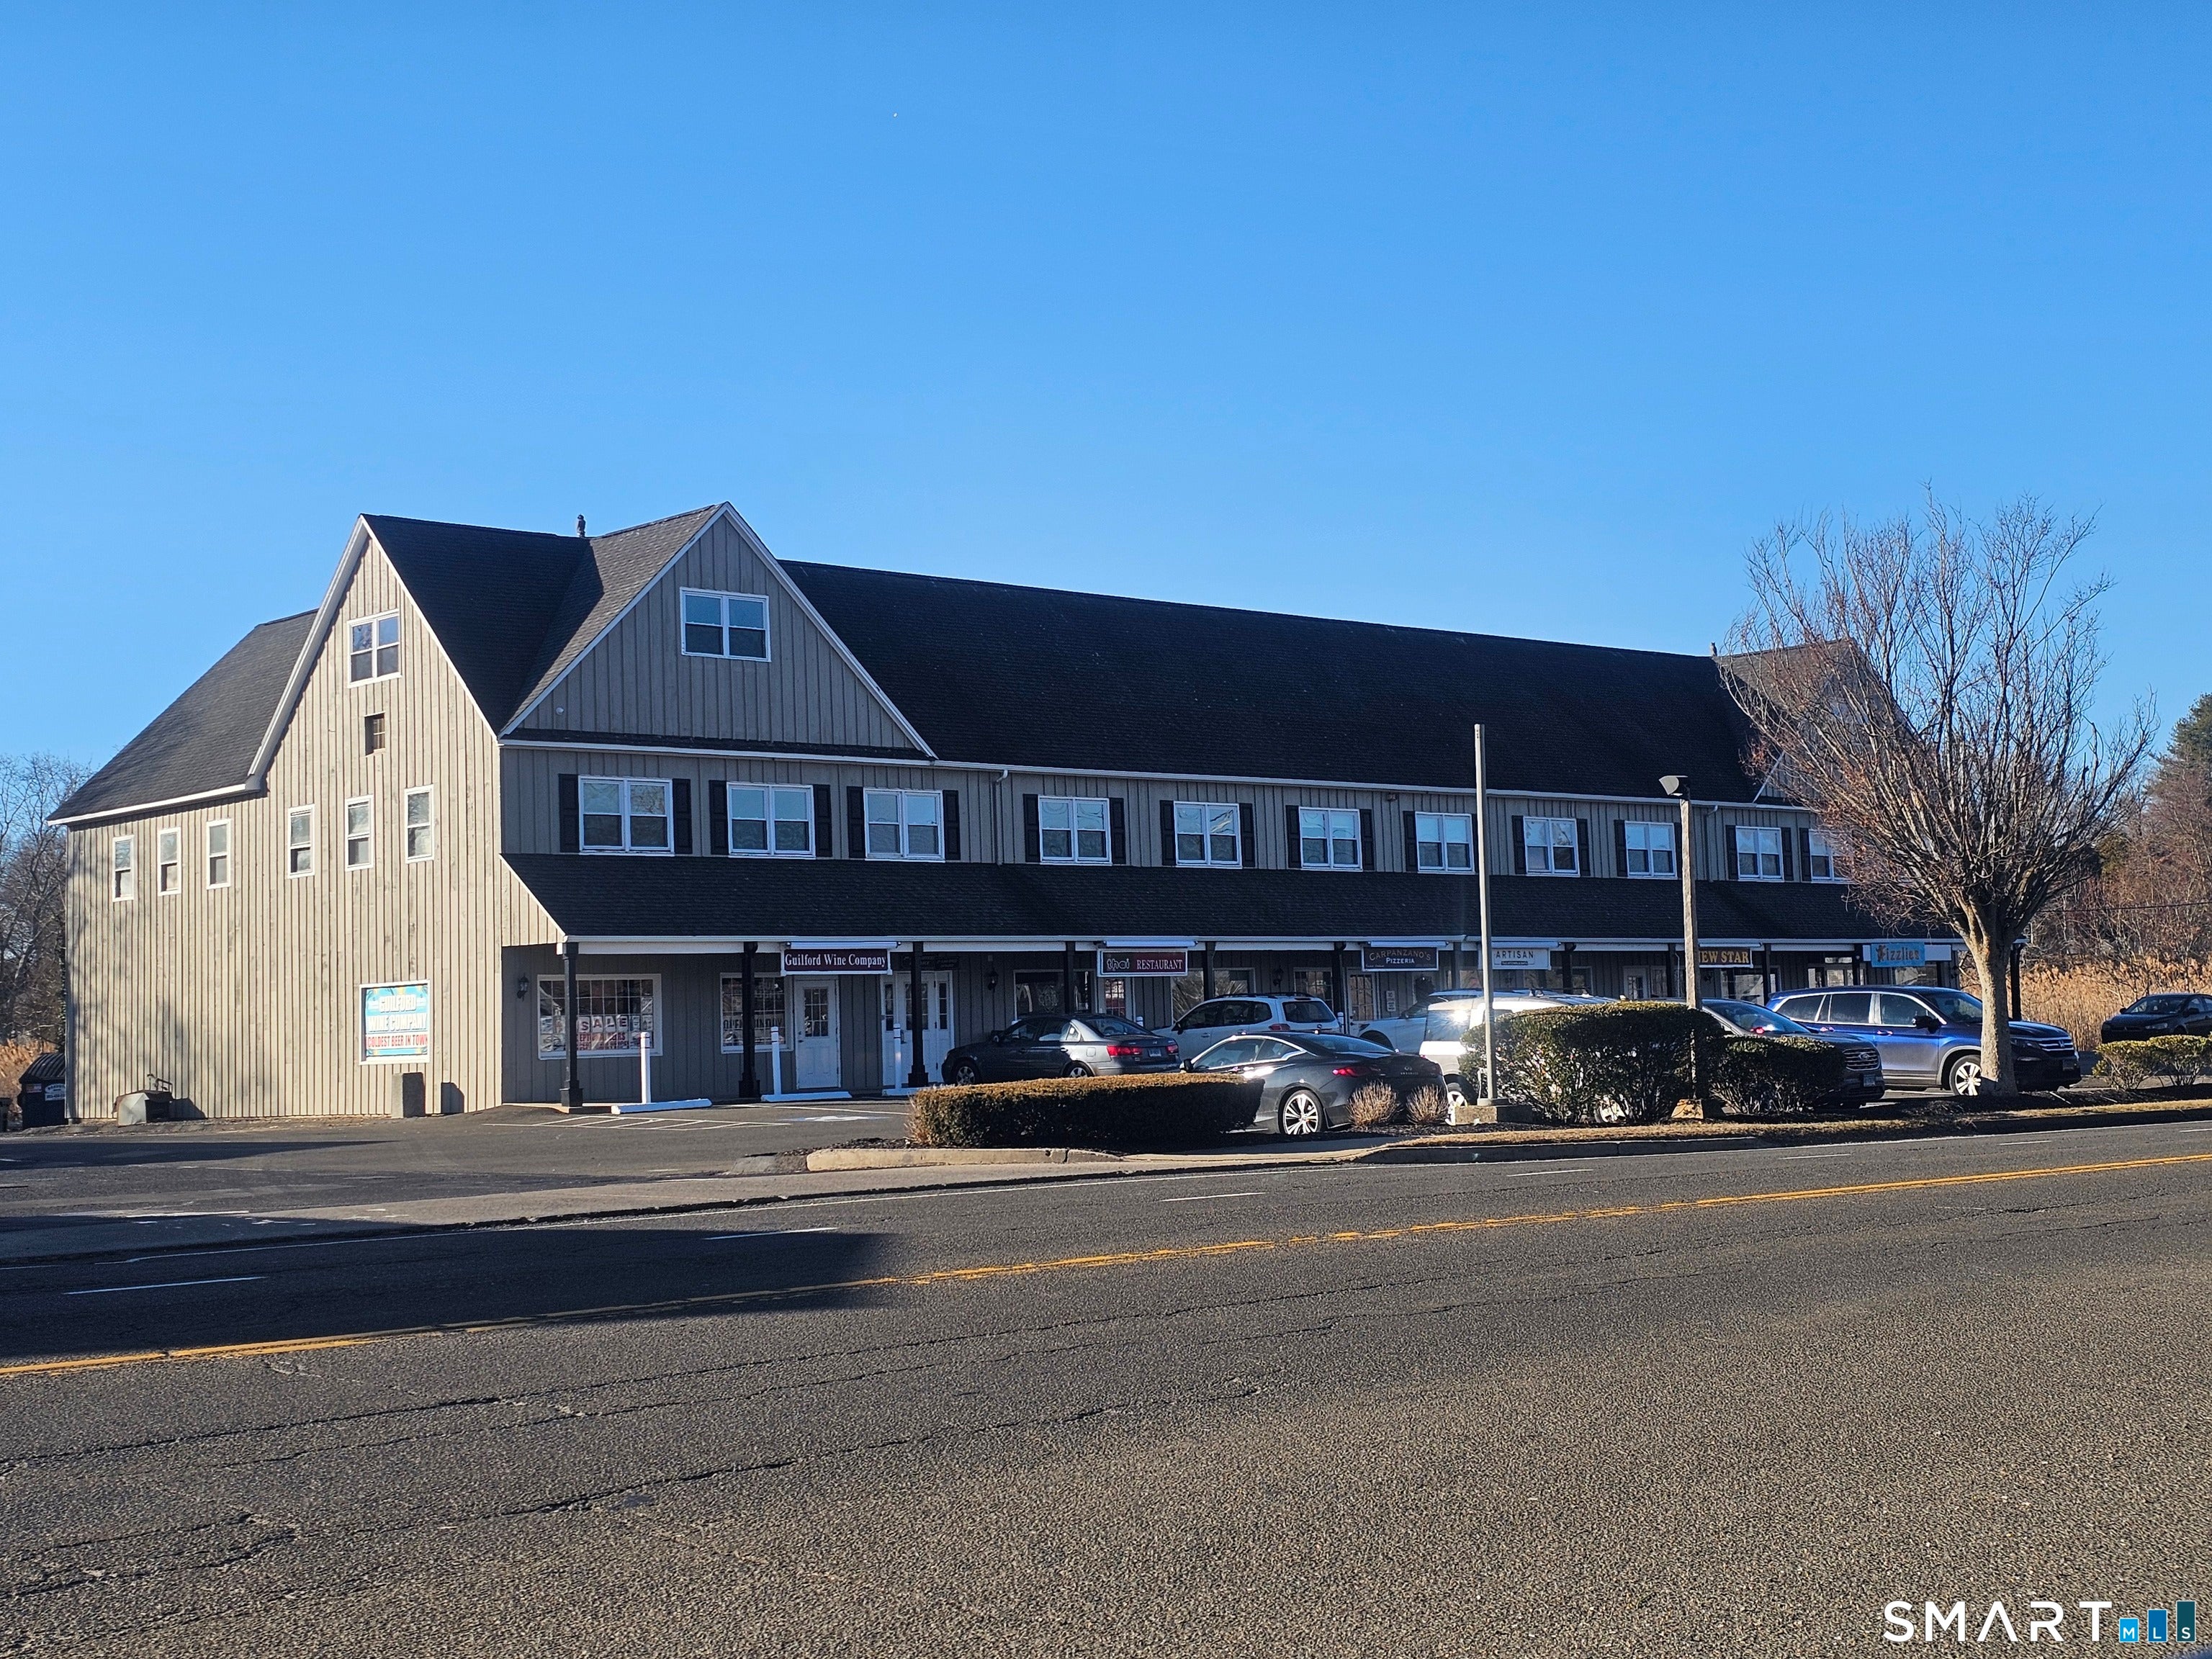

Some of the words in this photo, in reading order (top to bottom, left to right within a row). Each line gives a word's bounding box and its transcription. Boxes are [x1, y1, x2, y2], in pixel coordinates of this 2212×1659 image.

[785, 953, 821, 966] Guilford
[824, 953, 847, 966] Wine
[848, 953, 886, 968] Company
[1369, 950, 1431, 961] CARPANZANO'S
[1496, 950, 1534, 959] ARTISAN
[1699, 950, 1718, 963] EW
[1721, 950, 1750, 963] STAR
[1136, 959, 1183, 970] RESTAURANT
[379, 995, 416, 1012] GUILFORD
[581, 1017, 627, 1031] SALE
[391, 1035, 404, 1047] BEER
[405, 1035, 411, 1046] IN
